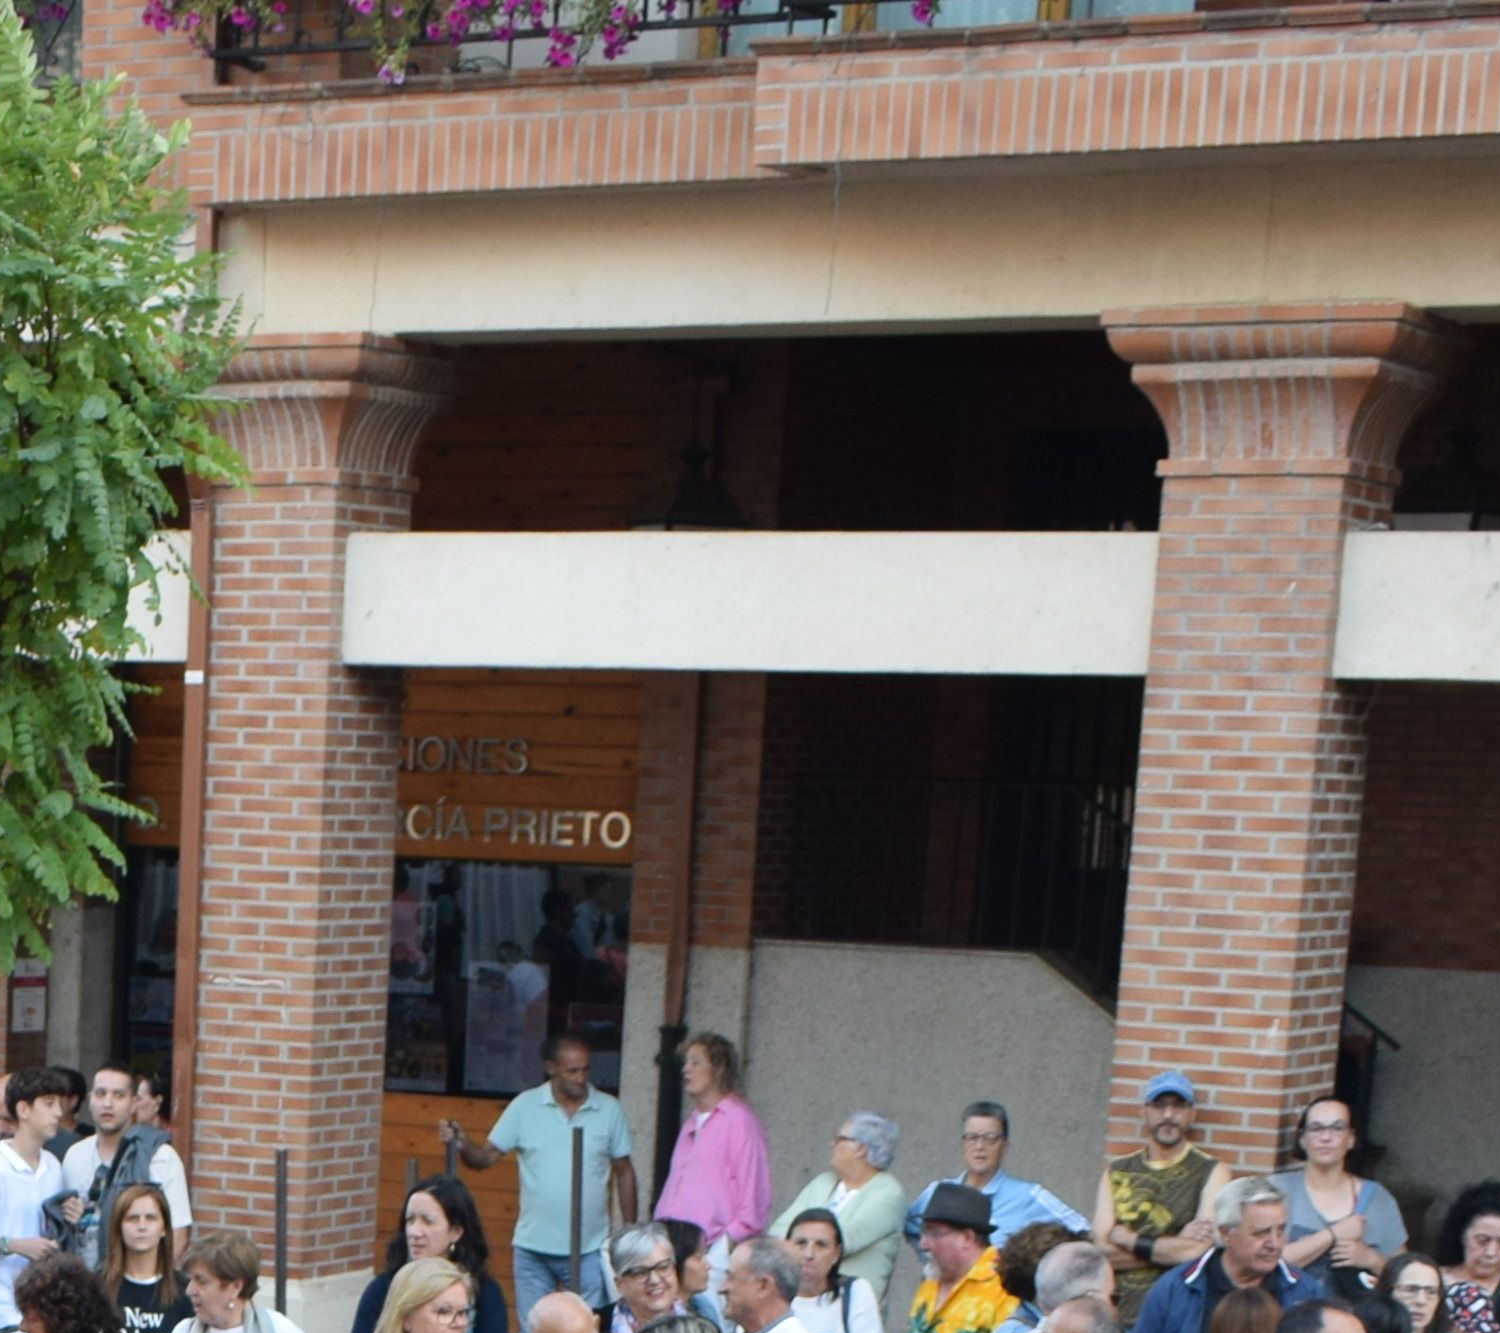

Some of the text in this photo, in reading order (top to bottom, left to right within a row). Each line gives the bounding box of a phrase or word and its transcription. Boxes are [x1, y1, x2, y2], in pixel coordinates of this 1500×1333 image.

[398, 736, 531, 775] IONES
[483, 806, 632, 848] PRIETO
[123, 1306, 165, 1328] New
